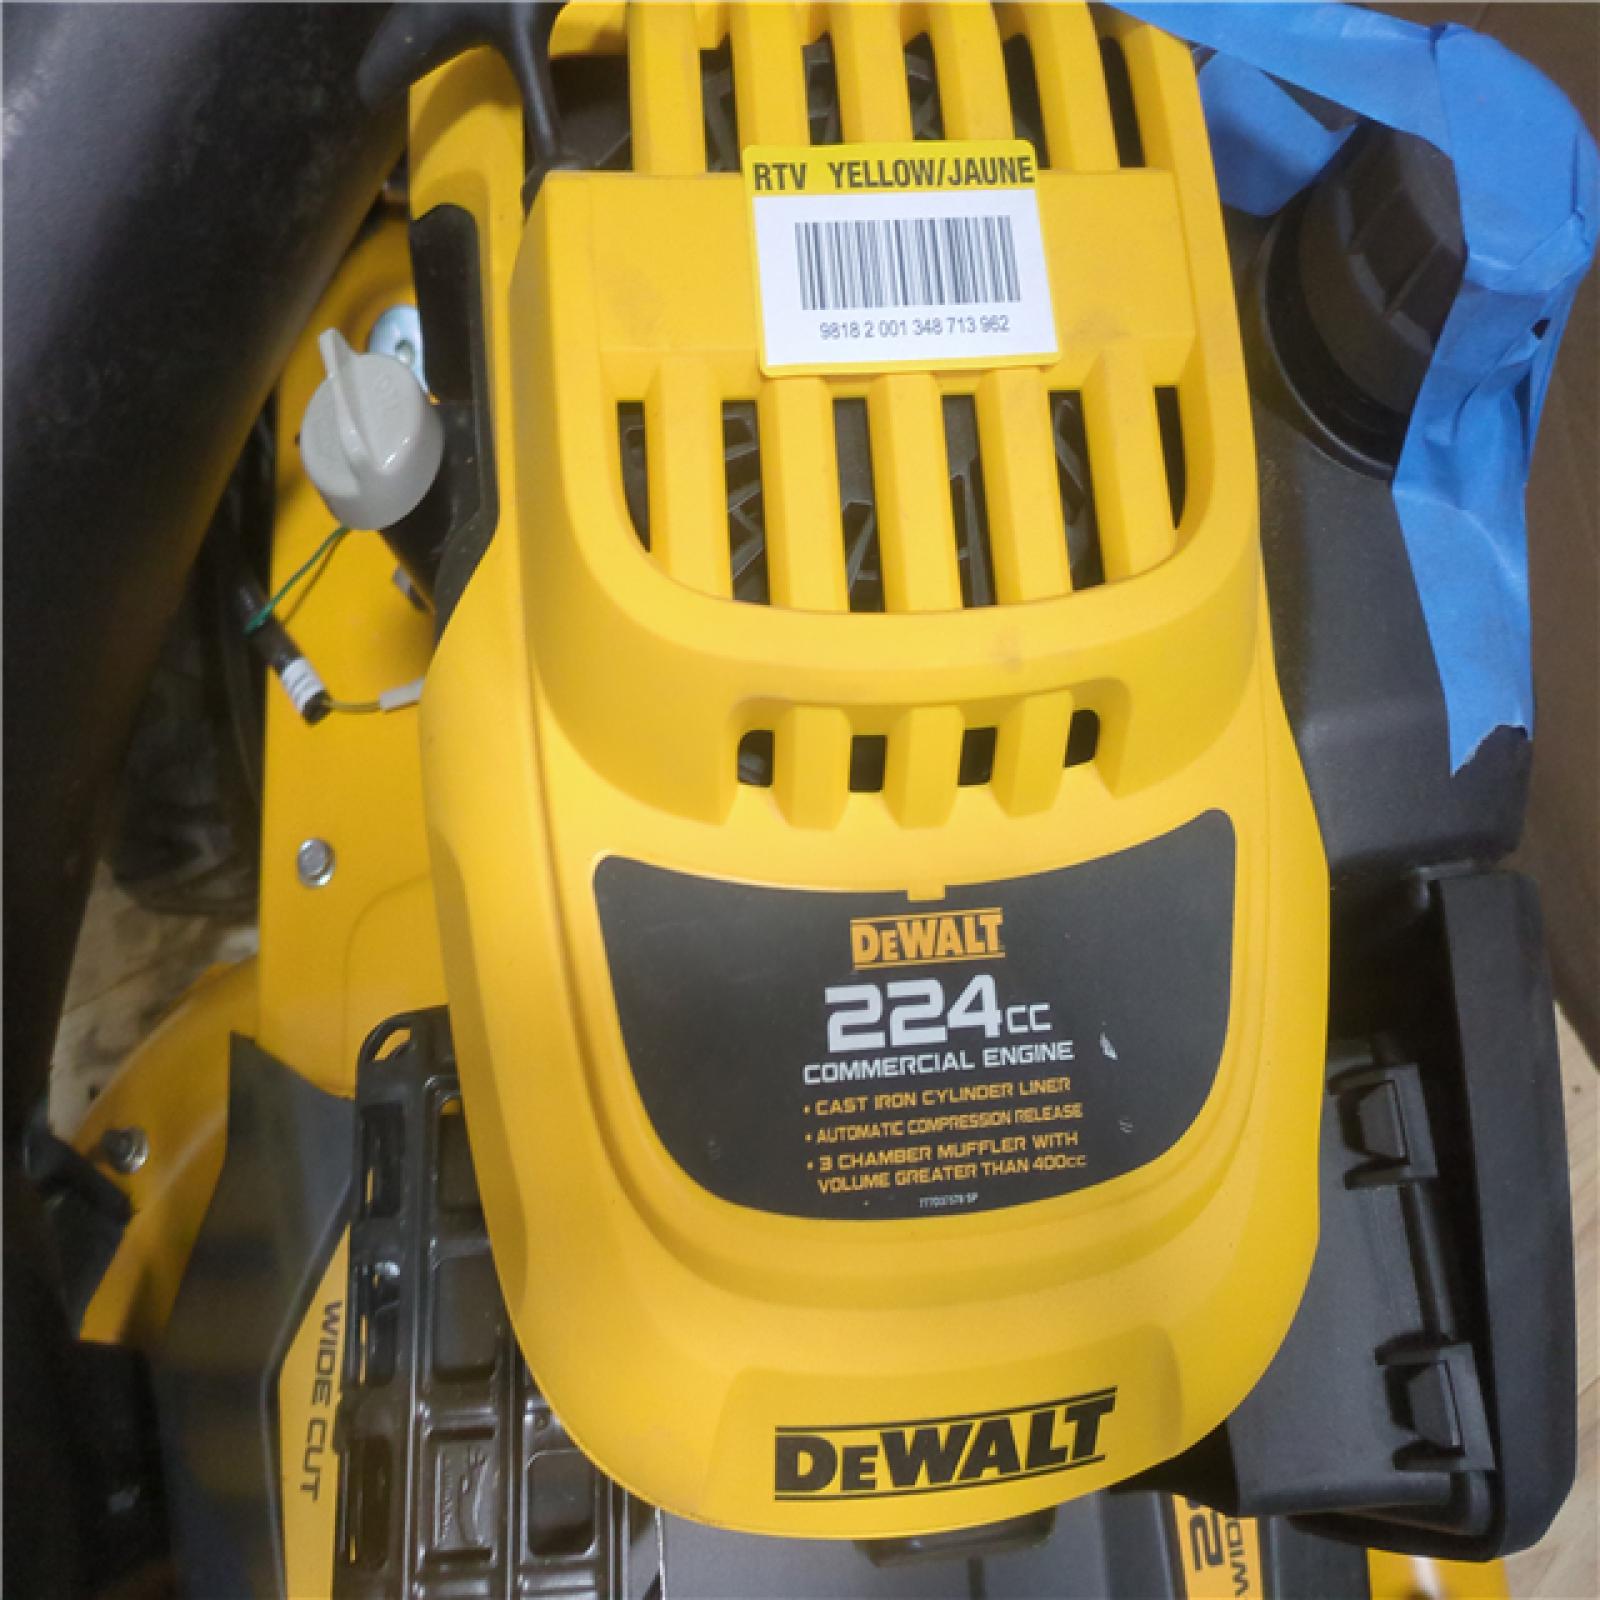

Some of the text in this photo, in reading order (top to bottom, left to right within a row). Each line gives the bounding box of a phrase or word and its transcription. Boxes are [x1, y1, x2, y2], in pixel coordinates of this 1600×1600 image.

[753, 156, 1035, 190] RTV YELLOW/JAUNE
[820, 321, 860, 340] 9818
[864, 320, 875, 338] 2
[879, 319, 907, 337] 001
[912, 317, 943, 335] 348
[947, 316, 976, 333] 713
[803, 1040, 1075, 1085] COMMERCIAL ENGINE
[815, 1076, 1070, 1115] CAST IRON CYLINDER LINER
[816, 1102, 1083, 1143] AUTOMATIC COMPRESSION RELEASE
[819, 1131, 1079, 1171] 3 CHAMBER MUFFLER WITH
[817, 1171, 890, 1194] VOLUME
[894, 1162, 977, 1186] GREATER
[979, 1157, 1029, 1177] THAN
[301, 1301, 342, 1503] WIDE CUT
